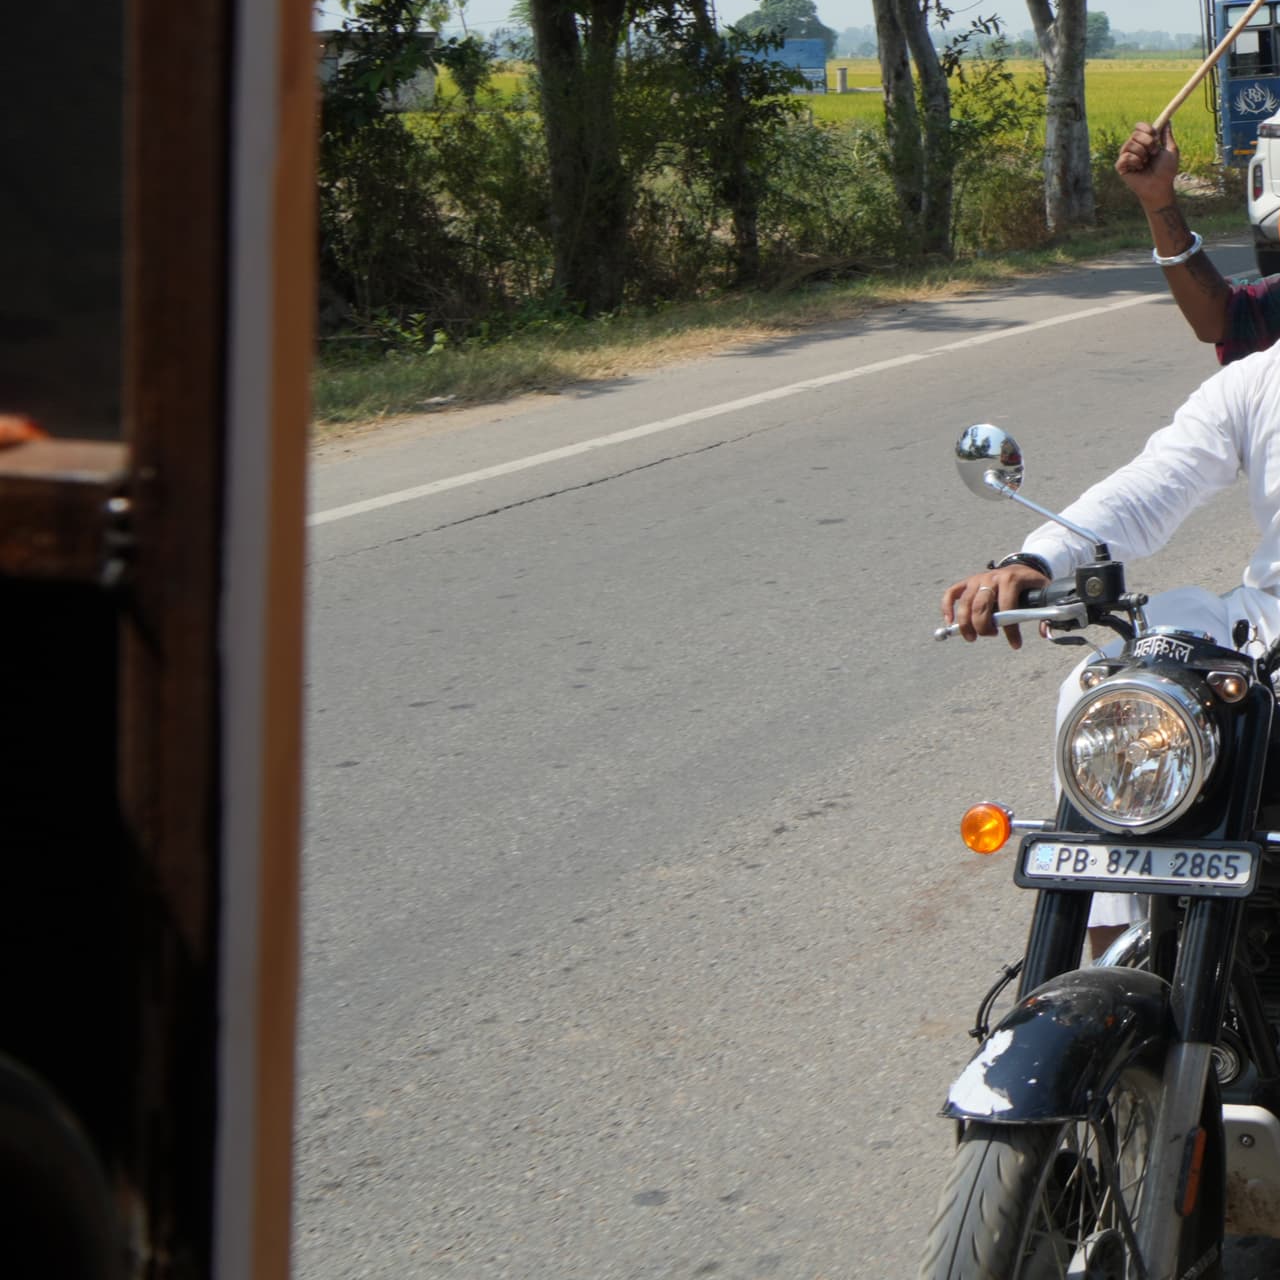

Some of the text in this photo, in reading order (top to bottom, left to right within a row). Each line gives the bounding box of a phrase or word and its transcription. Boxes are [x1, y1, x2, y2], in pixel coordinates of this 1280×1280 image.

[1056, 847, 1241, 880] PB 87A 2865
